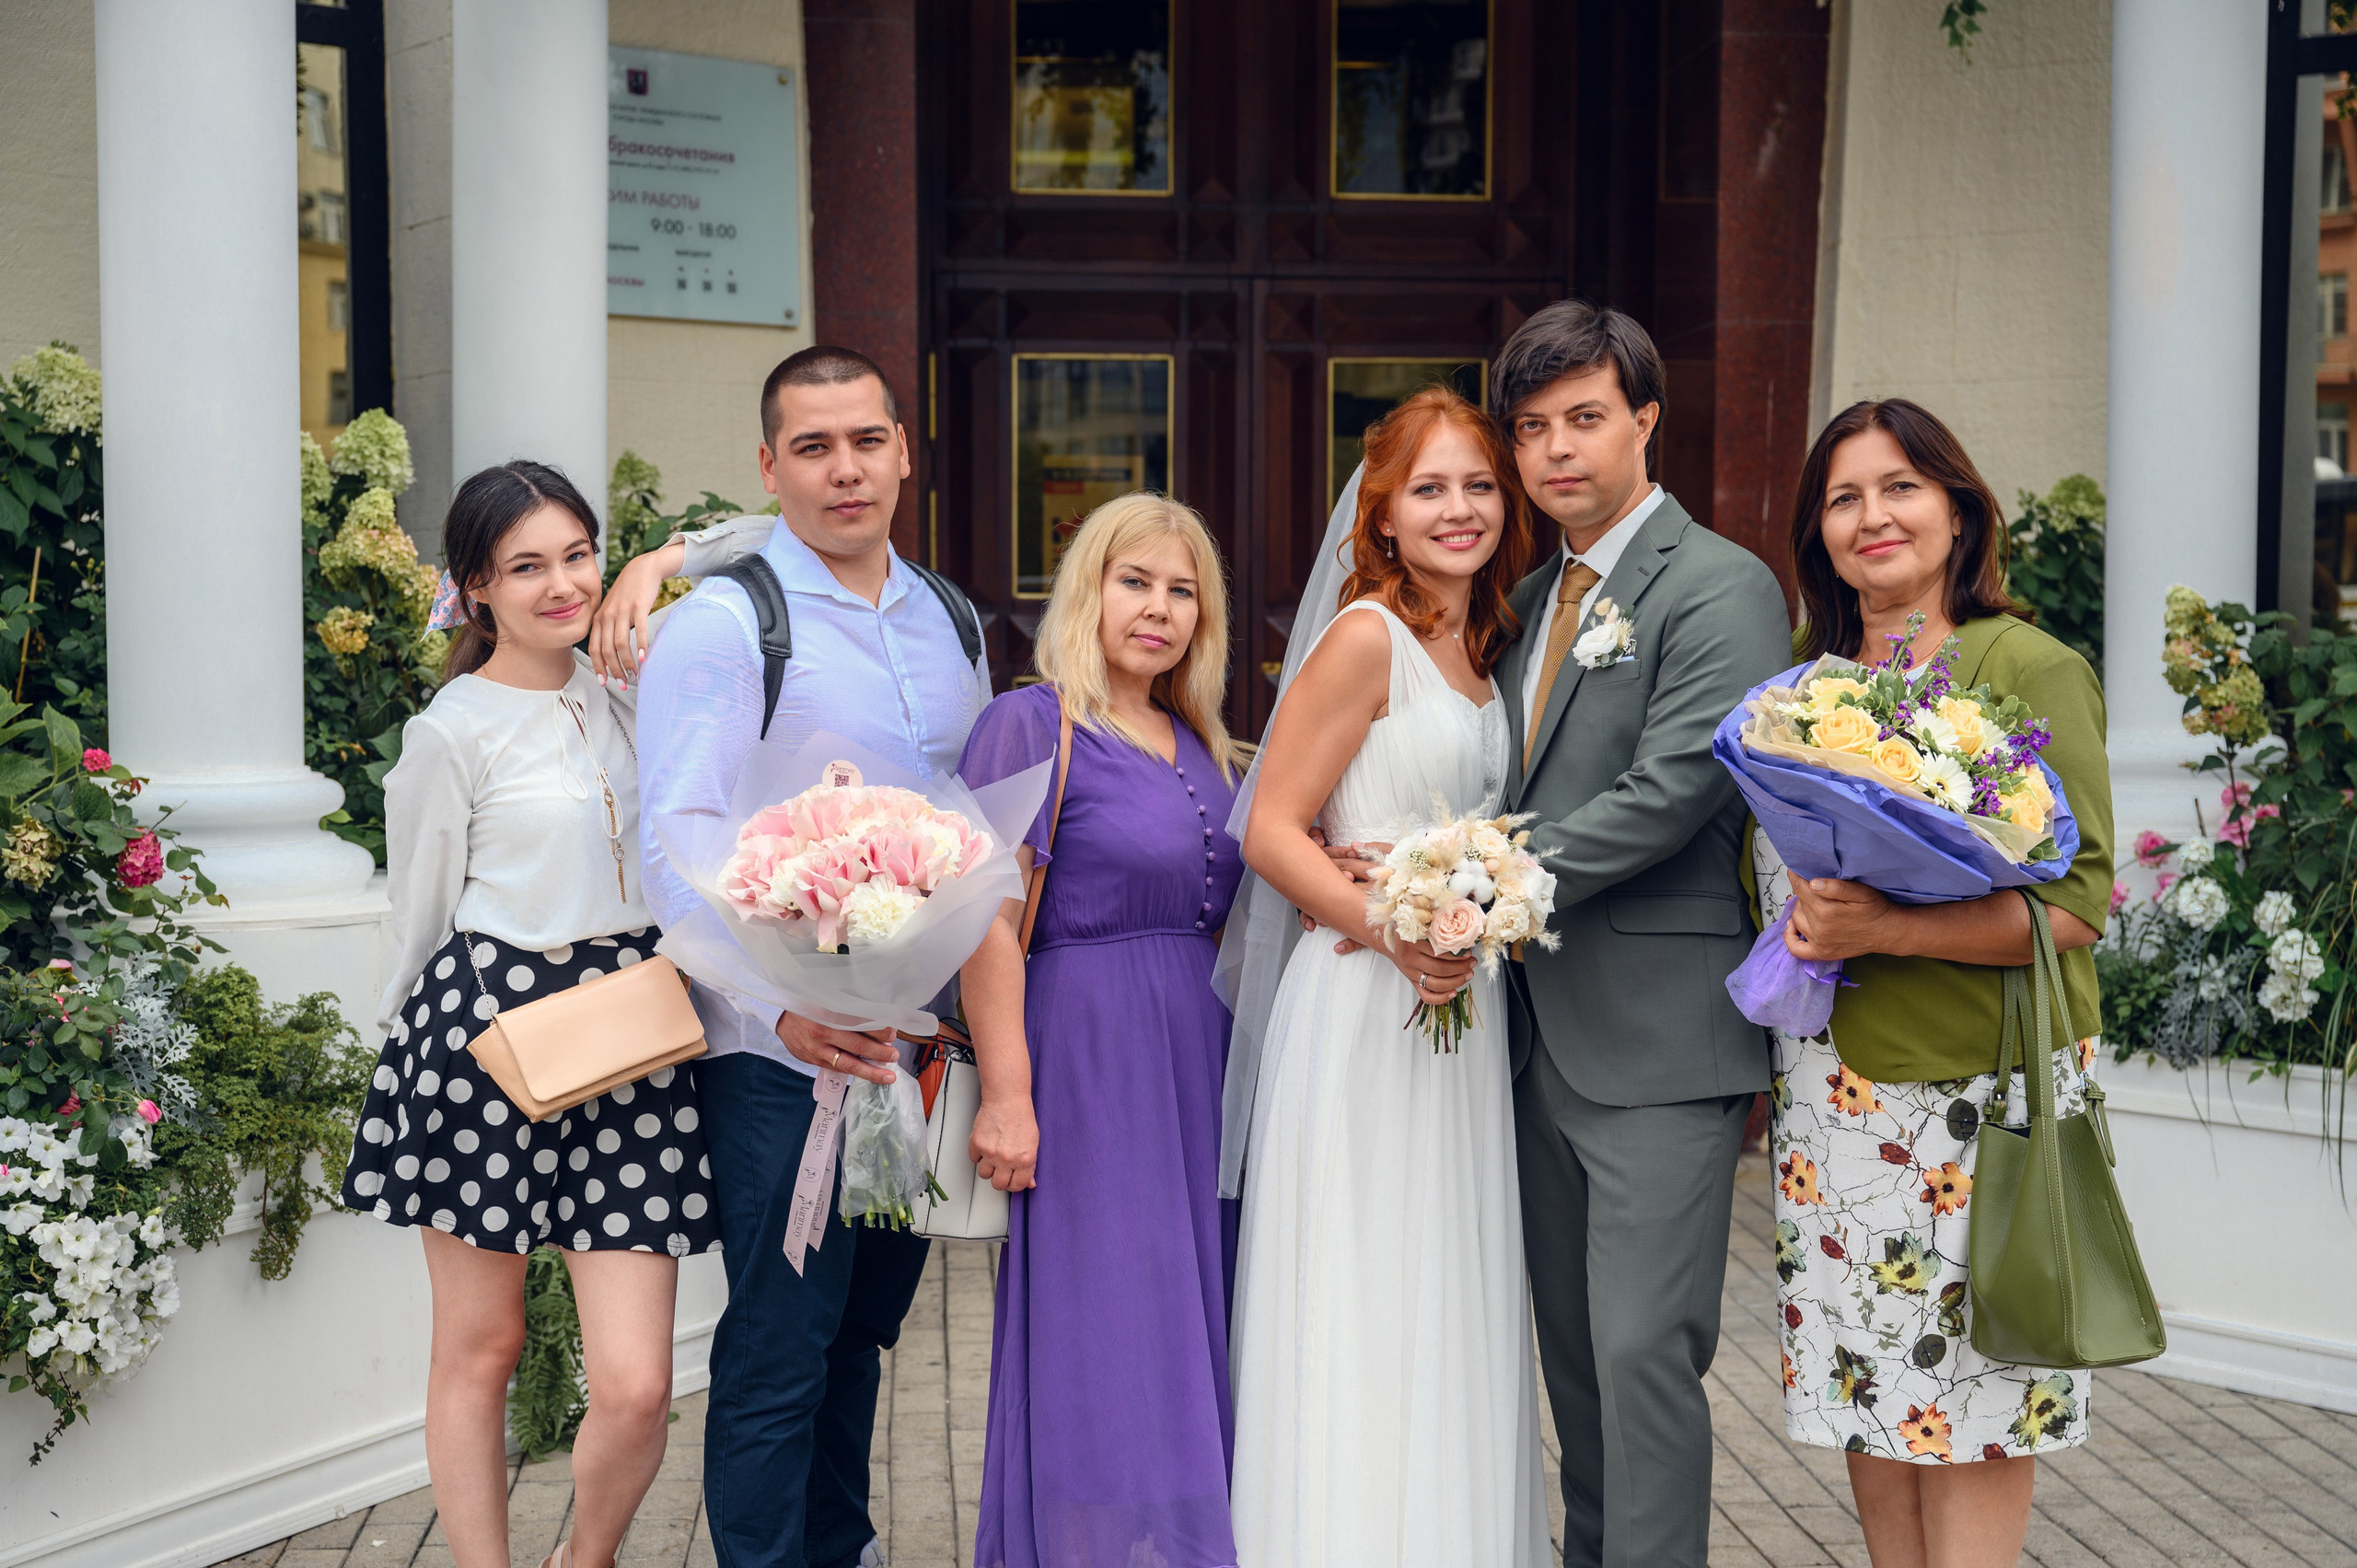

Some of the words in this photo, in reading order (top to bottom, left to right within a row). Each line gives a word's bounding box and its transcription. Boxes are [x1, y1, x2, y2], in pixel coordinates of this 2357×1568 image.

[609, 134, 736, 164] бракосочетания
[641, 191, 700, 211] РАБОТЫ
[698, 222, 737, 239] 18:00
[813, 1105, 838, 1154] Marimay
[793, 1194, 814, 1240] Marimay
